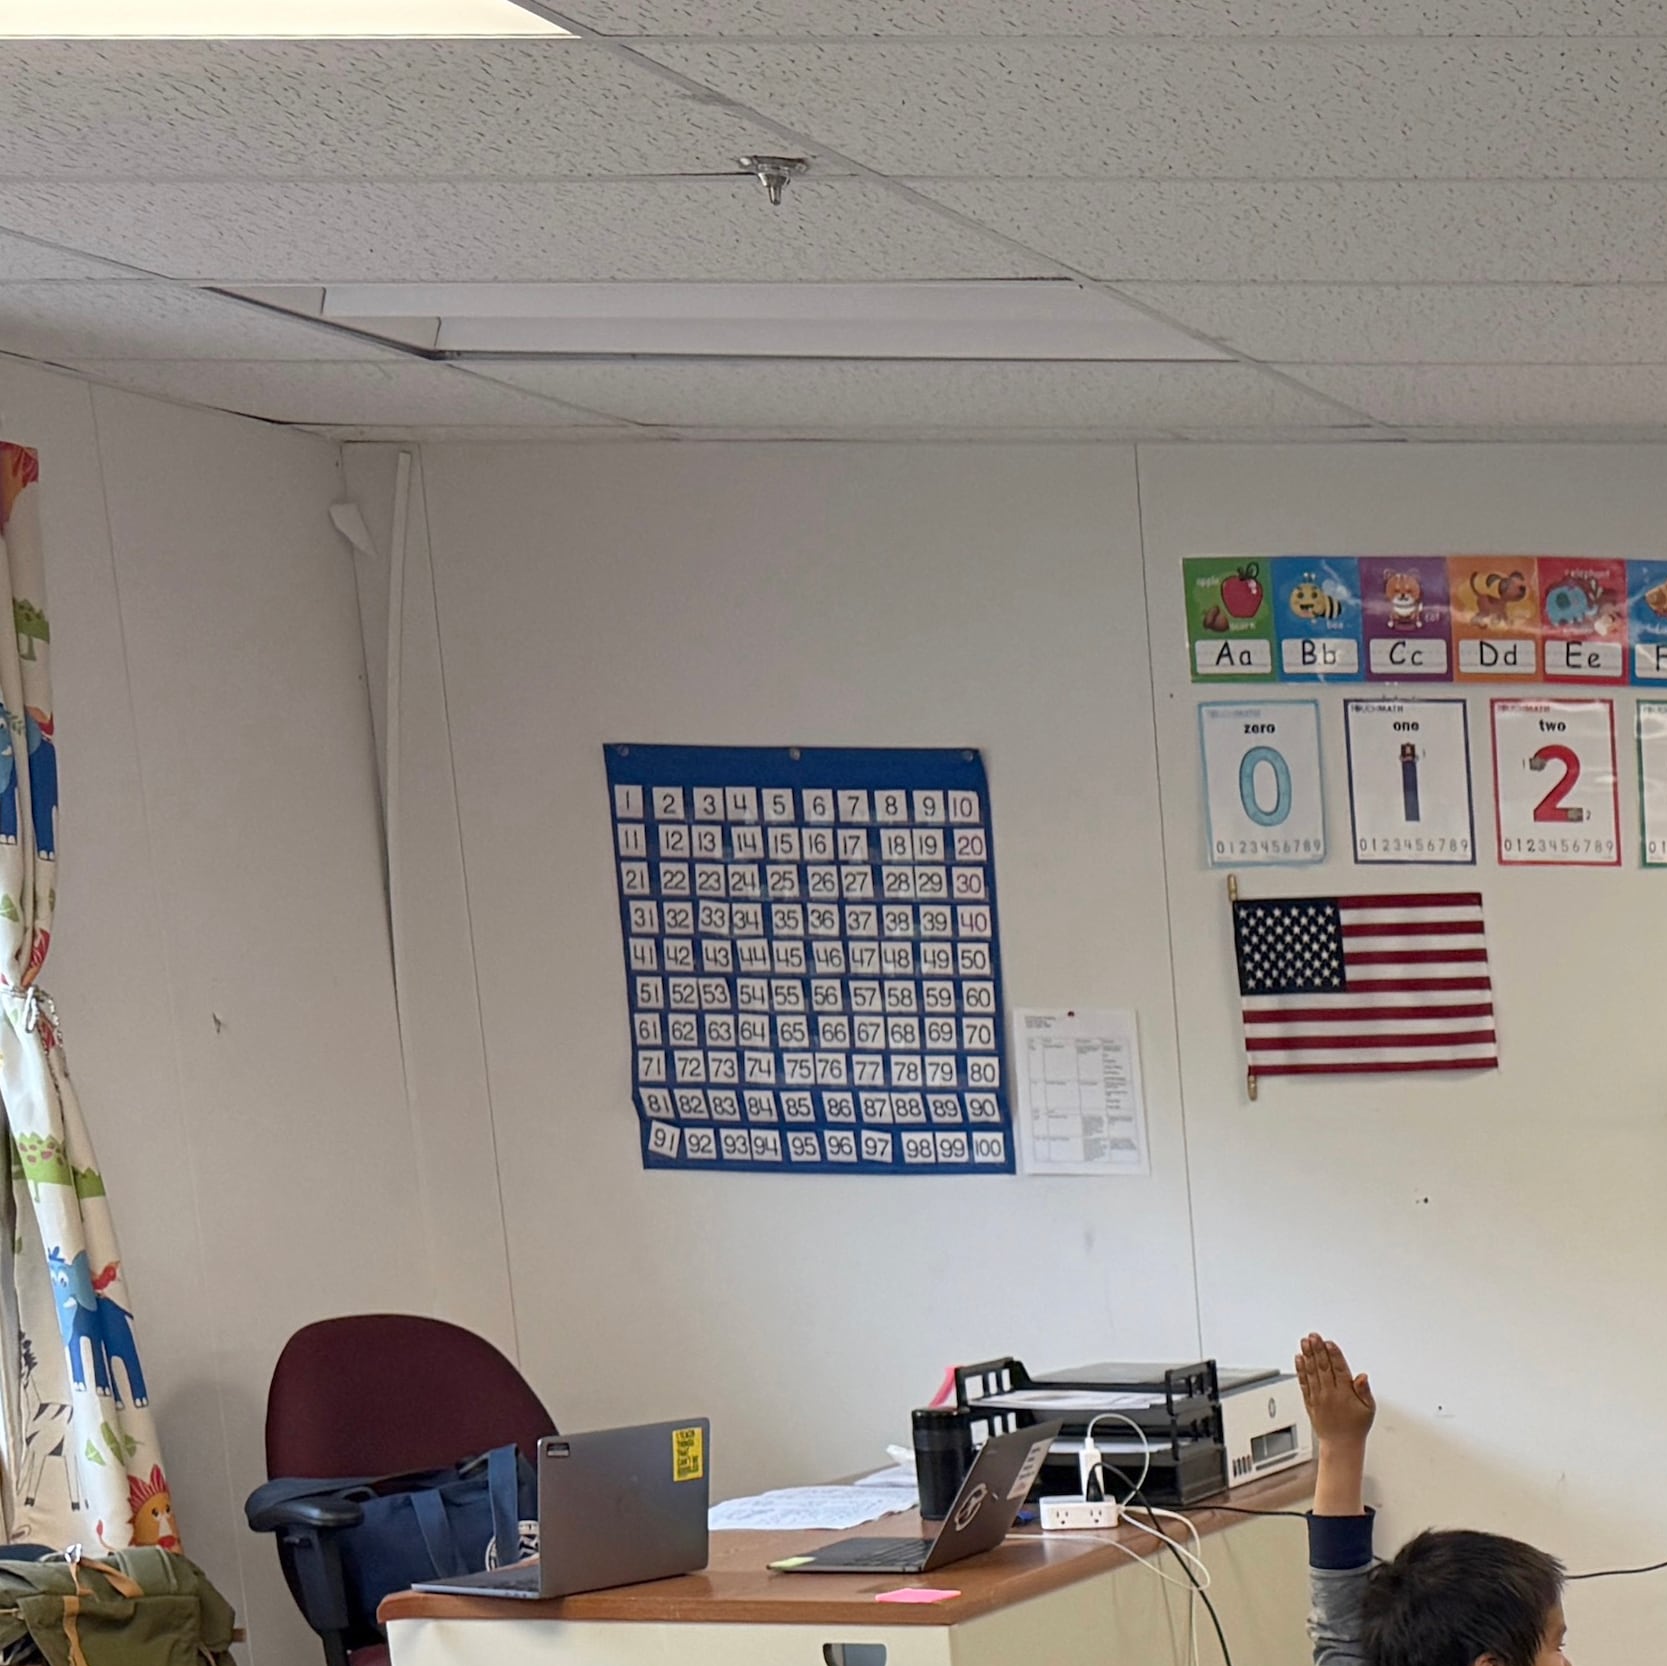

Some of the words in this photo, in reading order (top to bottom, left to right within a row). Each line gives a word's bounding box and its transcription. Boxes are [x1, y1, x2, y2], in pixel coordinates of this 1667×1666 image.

[1243, 721, 1276, 735] zero
[1393, 719, 1420, 732] one
[1538, 719, 1567, 733] two
[1239, 744, 1292, 827] 0
[1401, 742, 1421, 822] 1
[1529, 743, 1584, 822] 2
[624, 791, 631, 808] 1
[663, 794, 676, 814] 2
[703, 794, 716, 815] 3
[733, 794, 747, 811] 4
[772, 795, 786, 815] 5
[813, 796, 825, 816] 6
[847, 796, 860, 816] 7
[885, 796, 898, 815] 8
[923, 796, 935, 816] 9
[952, 797, 972, 817] 10
[957, 836, 983, 856] 20
[975, 1139, 1001, 1158] 100
